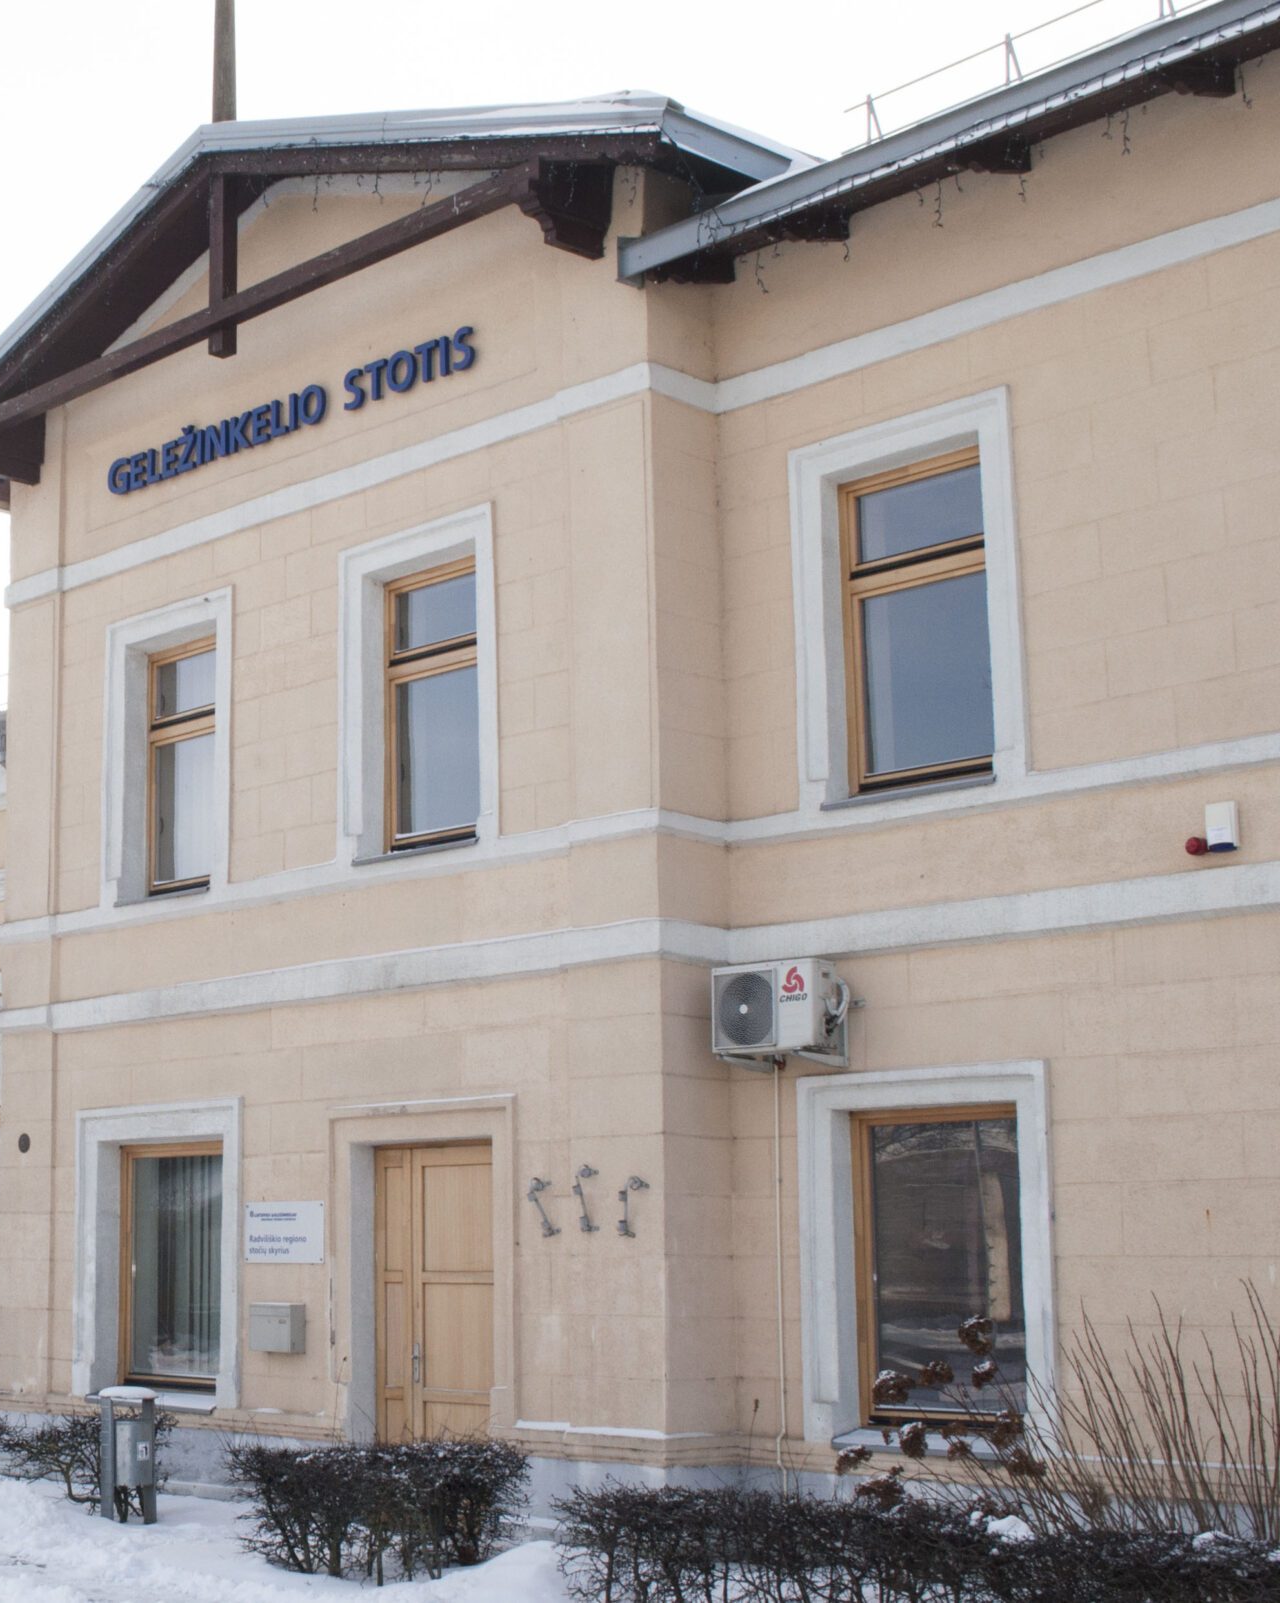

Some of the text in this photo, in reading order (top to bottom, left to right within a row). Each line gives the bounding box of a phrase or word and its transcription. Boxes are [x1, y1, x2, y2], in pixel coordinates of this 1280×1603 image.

[107, 326, 476, 495] GELEŽINKELIO STOTIS
[779, 993, 808, 1003] CHIGO
[283, 1235, 307, 1244] regiono
